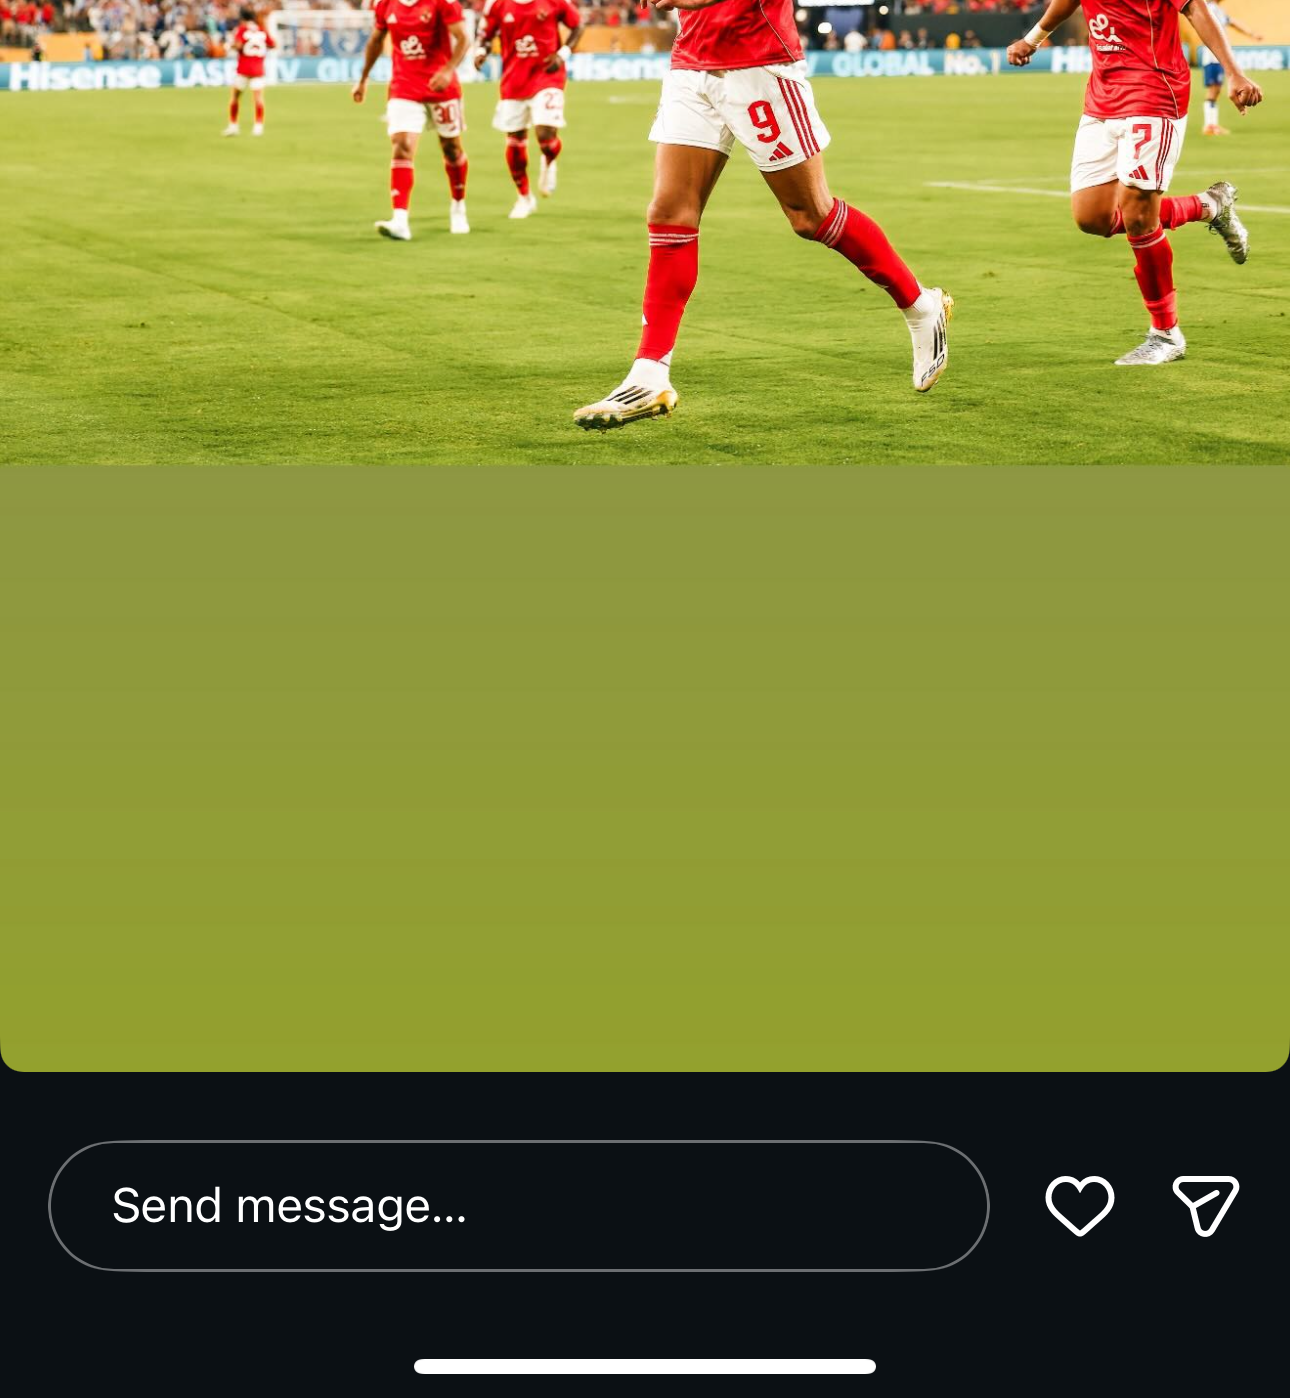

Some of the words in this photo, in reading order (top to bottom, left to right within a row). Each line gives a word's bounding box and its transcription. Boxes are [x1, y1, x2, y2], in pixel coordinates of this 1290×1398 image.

[8, 62, 161, 91] Hisense
[831, 50, 935, 77] GLOBAL
[747, 100, 781, 143] 9
[1132, 124, 1152, 159] 7
[921, 353, 945, 387] F50
